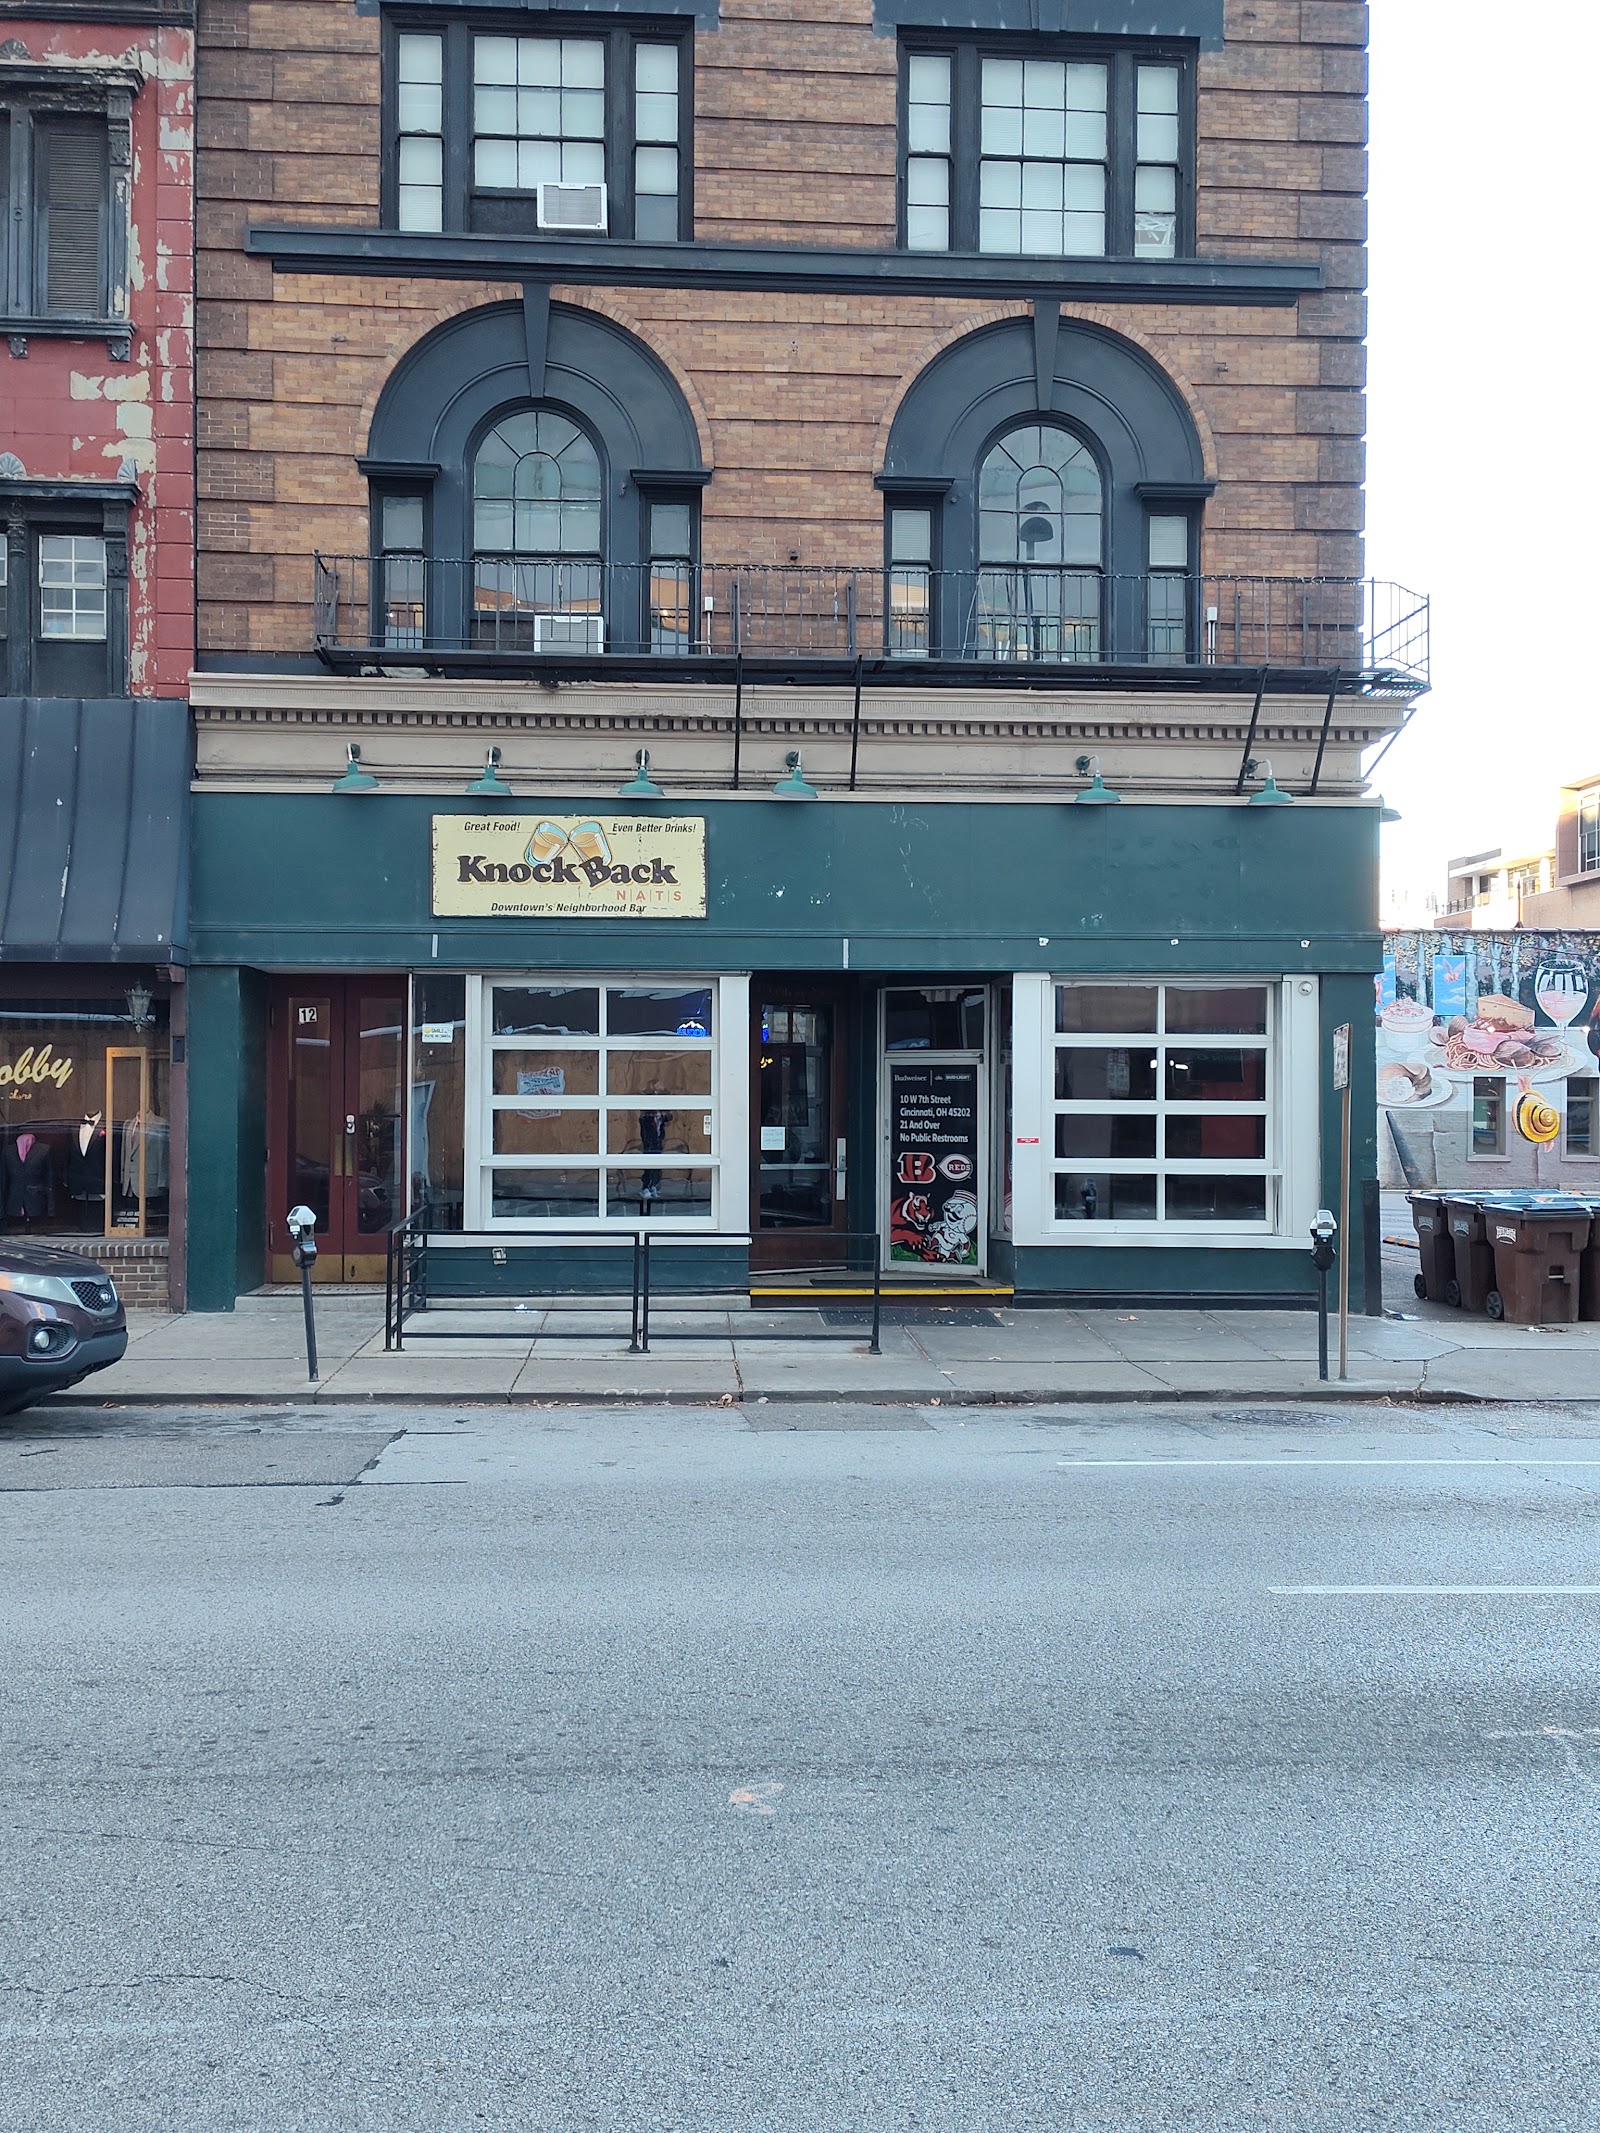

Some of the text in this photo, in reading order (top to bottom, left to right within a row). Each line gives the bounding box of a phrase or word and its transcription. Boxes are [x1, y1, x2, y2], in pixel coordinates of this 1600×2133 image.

[464, 821, 521, 832] Great Food!
[612, 823, 696, 833] Even Better Drinks!
[457, 855, 679, 888] Knock Back
[491, 902, 647, 913] Downtown's Neighborhood Bar
[301, 1008, 316, 1022] 12
[894, 1074, 928, 1082] Budweiser
[900, 1095, 952, 1104] 10 W 7th Street
[900, 1107, 971, 1118] Cincinnati, OH 45202
[899, 1120, 940, 1130] 21 And Over
[900, 1133, 969, 1143] No Public Restrooms
[896, 1152, 936, 1184] B
